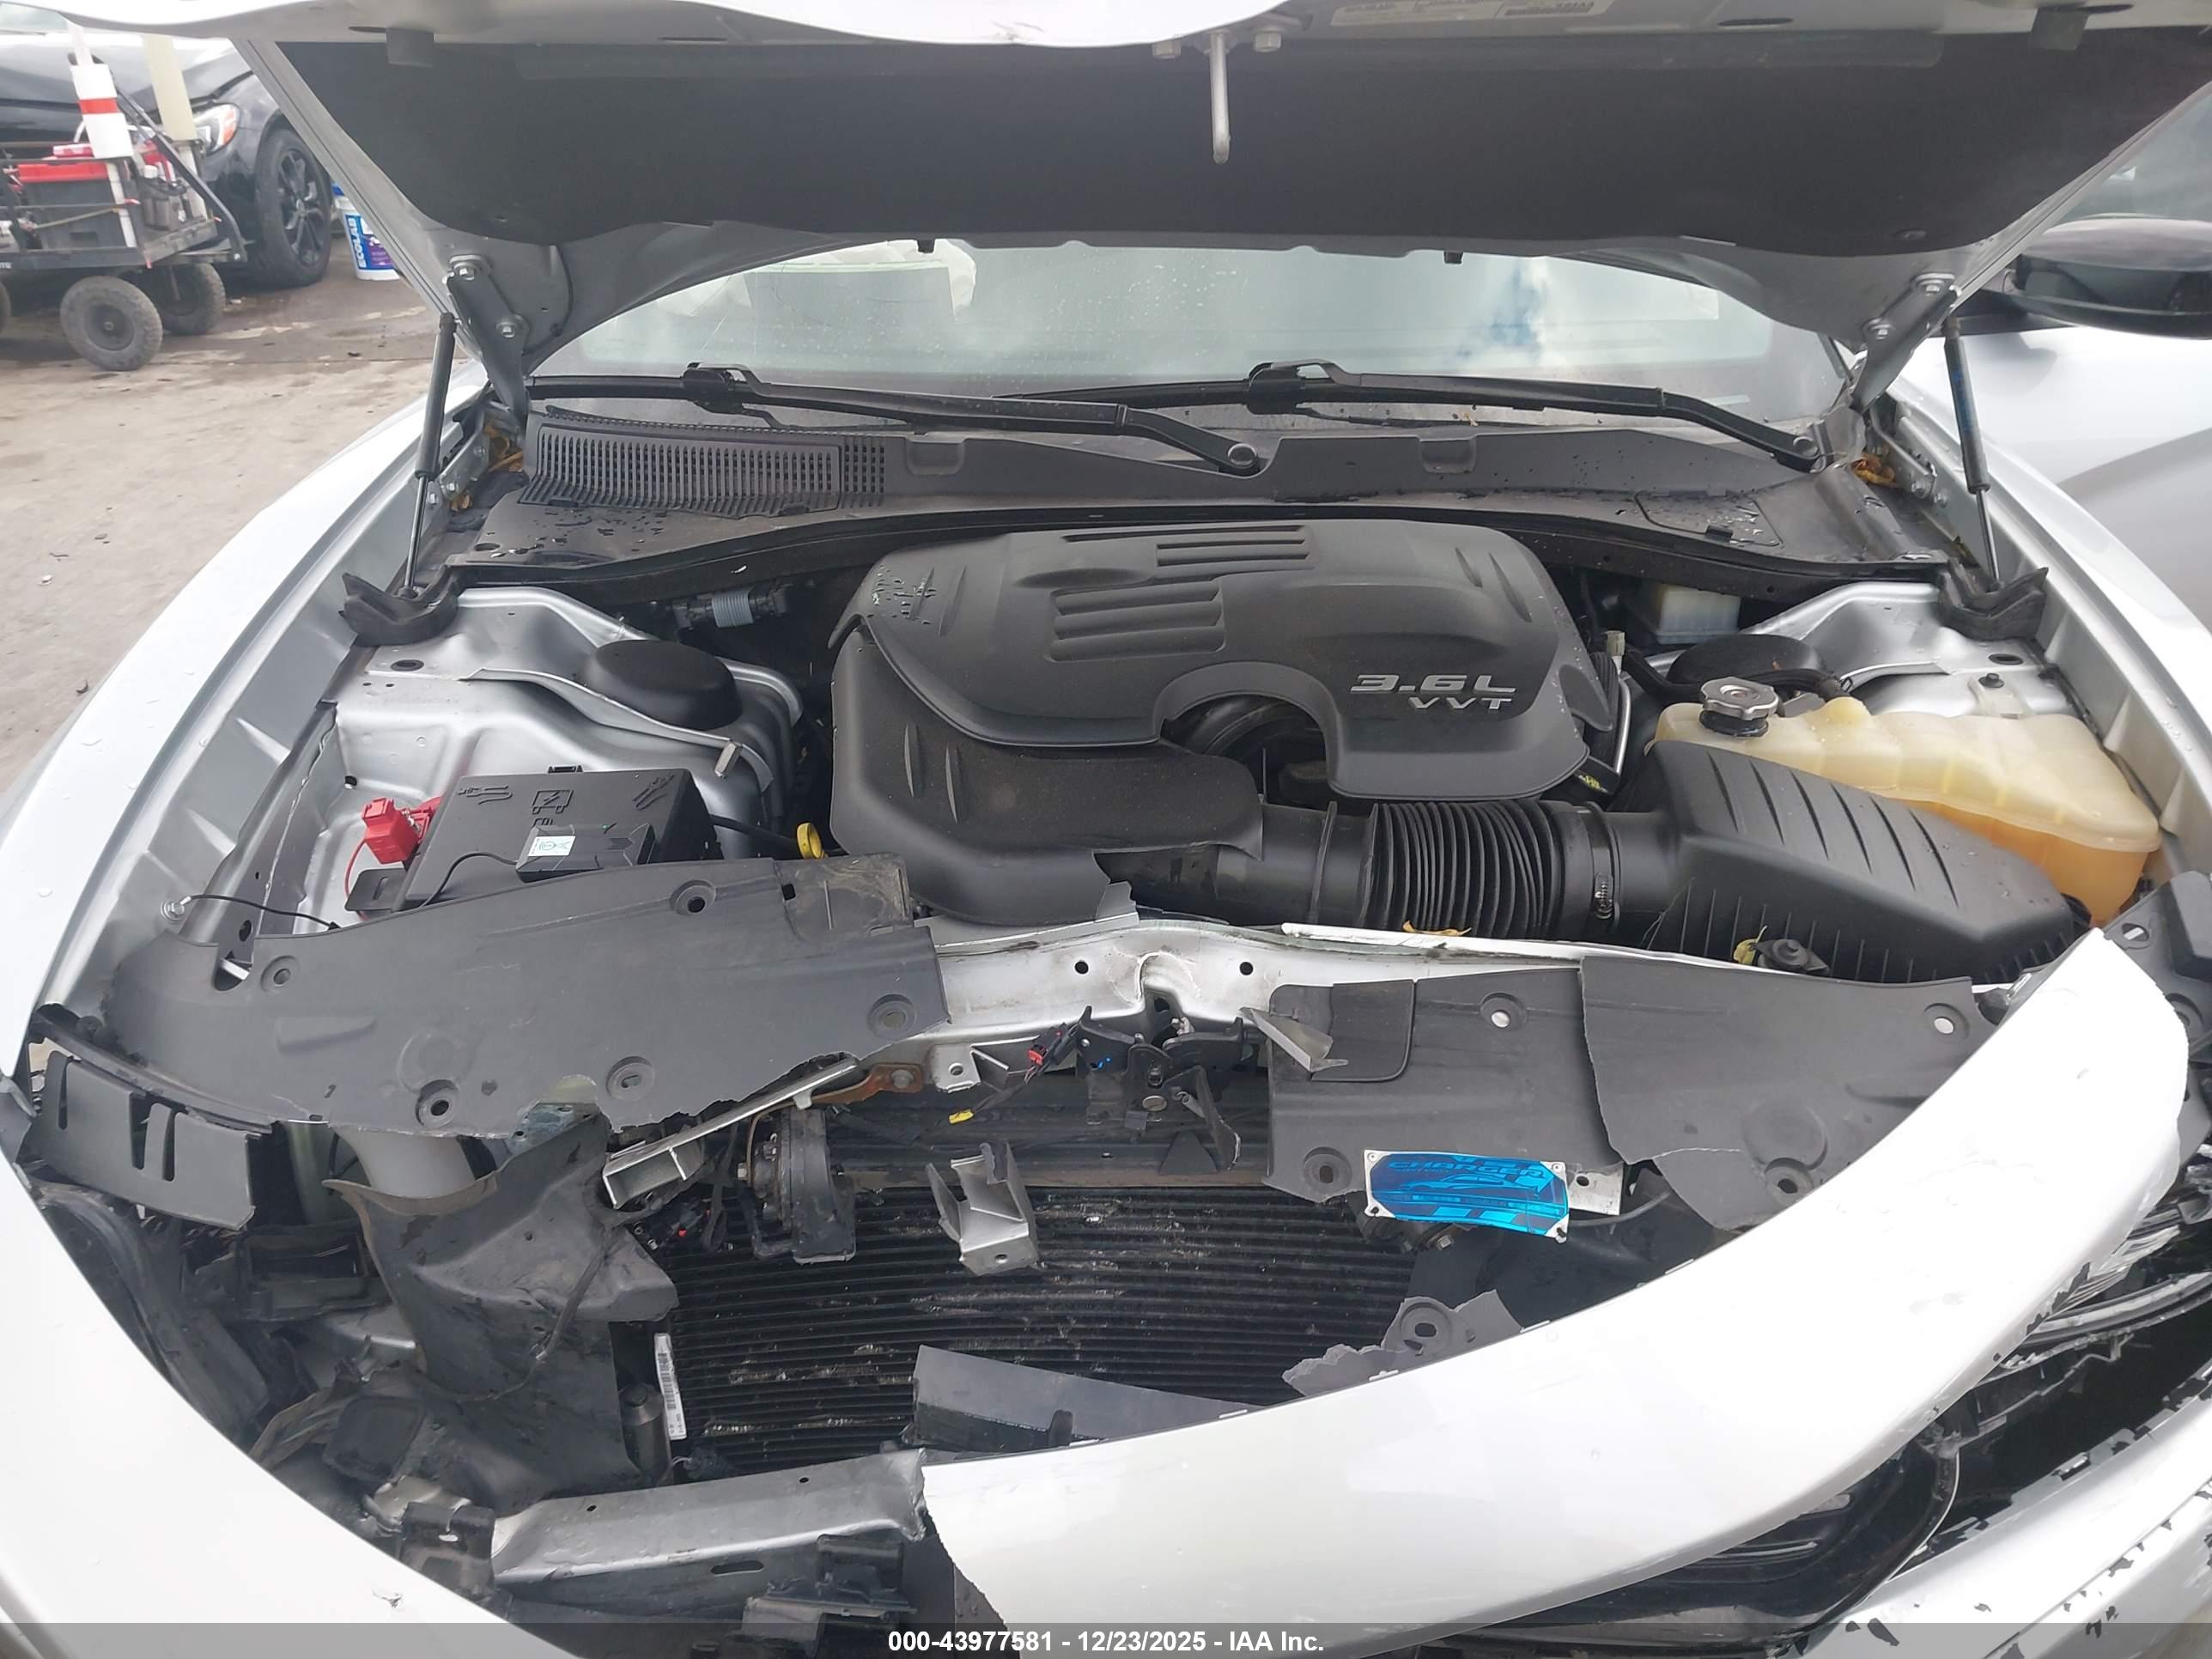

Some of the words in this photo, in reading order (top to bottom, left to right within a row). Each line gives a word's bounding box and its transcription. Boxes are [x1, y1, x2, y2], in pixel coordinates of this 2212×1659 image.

[348, 218, 367, 268] ECOLAB
[1351, 674, 1516, 694] 3.6L
[1408, 696, 1512, 710] VVT
[1388, 1160, 1545, 1180] CHARGER
